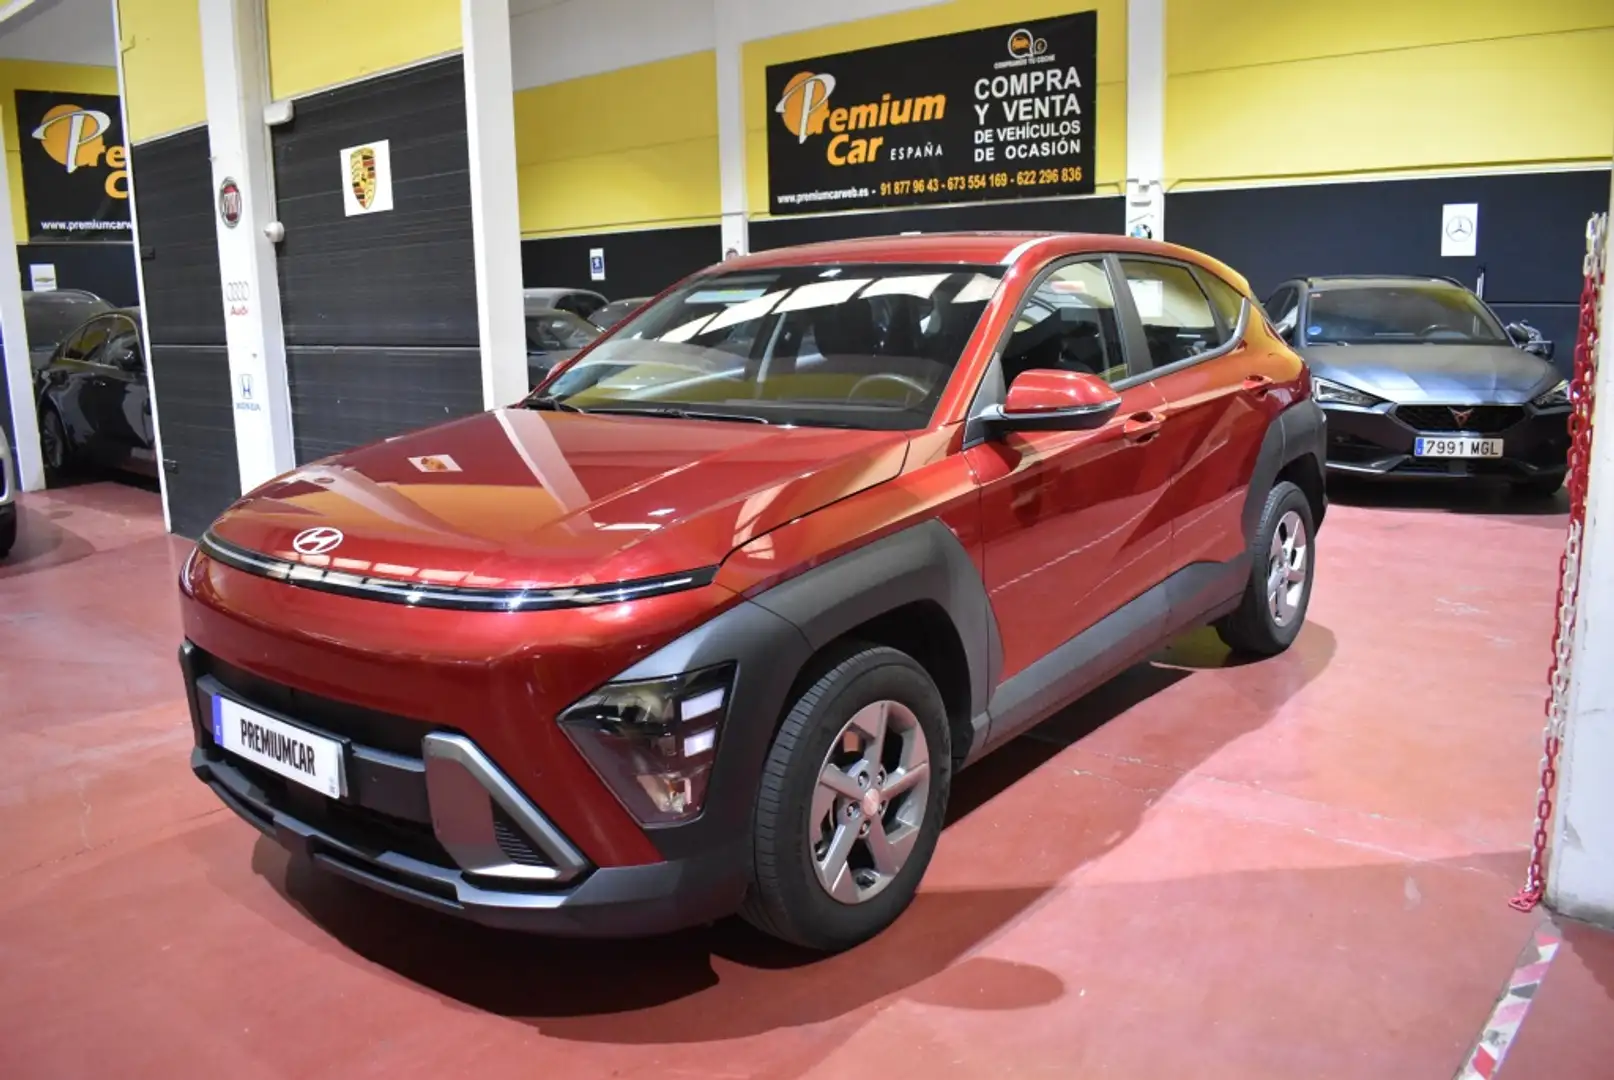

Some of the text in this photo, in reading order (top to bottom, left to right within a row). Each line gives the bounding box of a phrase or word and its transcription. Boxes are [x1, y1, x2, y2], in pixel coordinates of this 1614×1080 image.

[974, 66, 1082, 101] COMPRA
[775, 73, 947, 144] Premium
[974, 93, 1082, 126] Y VENTA
[974, 120, 1081, 144] DE VEHÍCULOS
[827, 133, 944, 167] Car ESPAÑA
[974, 137, 1081, 162] DE OCASIÓN
[777, 186, 869, 205] www.premiumcarweb.es
[880, 182, 892, 196] 91
[894, 180, 911, 195] 877
[913, 178, 925, 194] 96
[926, 178, 939, 192] 43
[947, 176, 966, 191] 673
[967, 174, 986, 189] 554
[988, 171, 1008, 187] 169
[1017, 170, 1037, 186] 622
[1061, 166, 1082, 182] 836
[41, 219, 132, 231] www.premiumcarw
[1426, 440, 1464, 455] 7991
[1470, 441, 1499, 455] MGL
[240, 718, 316, 776] PREMIUMCAR
